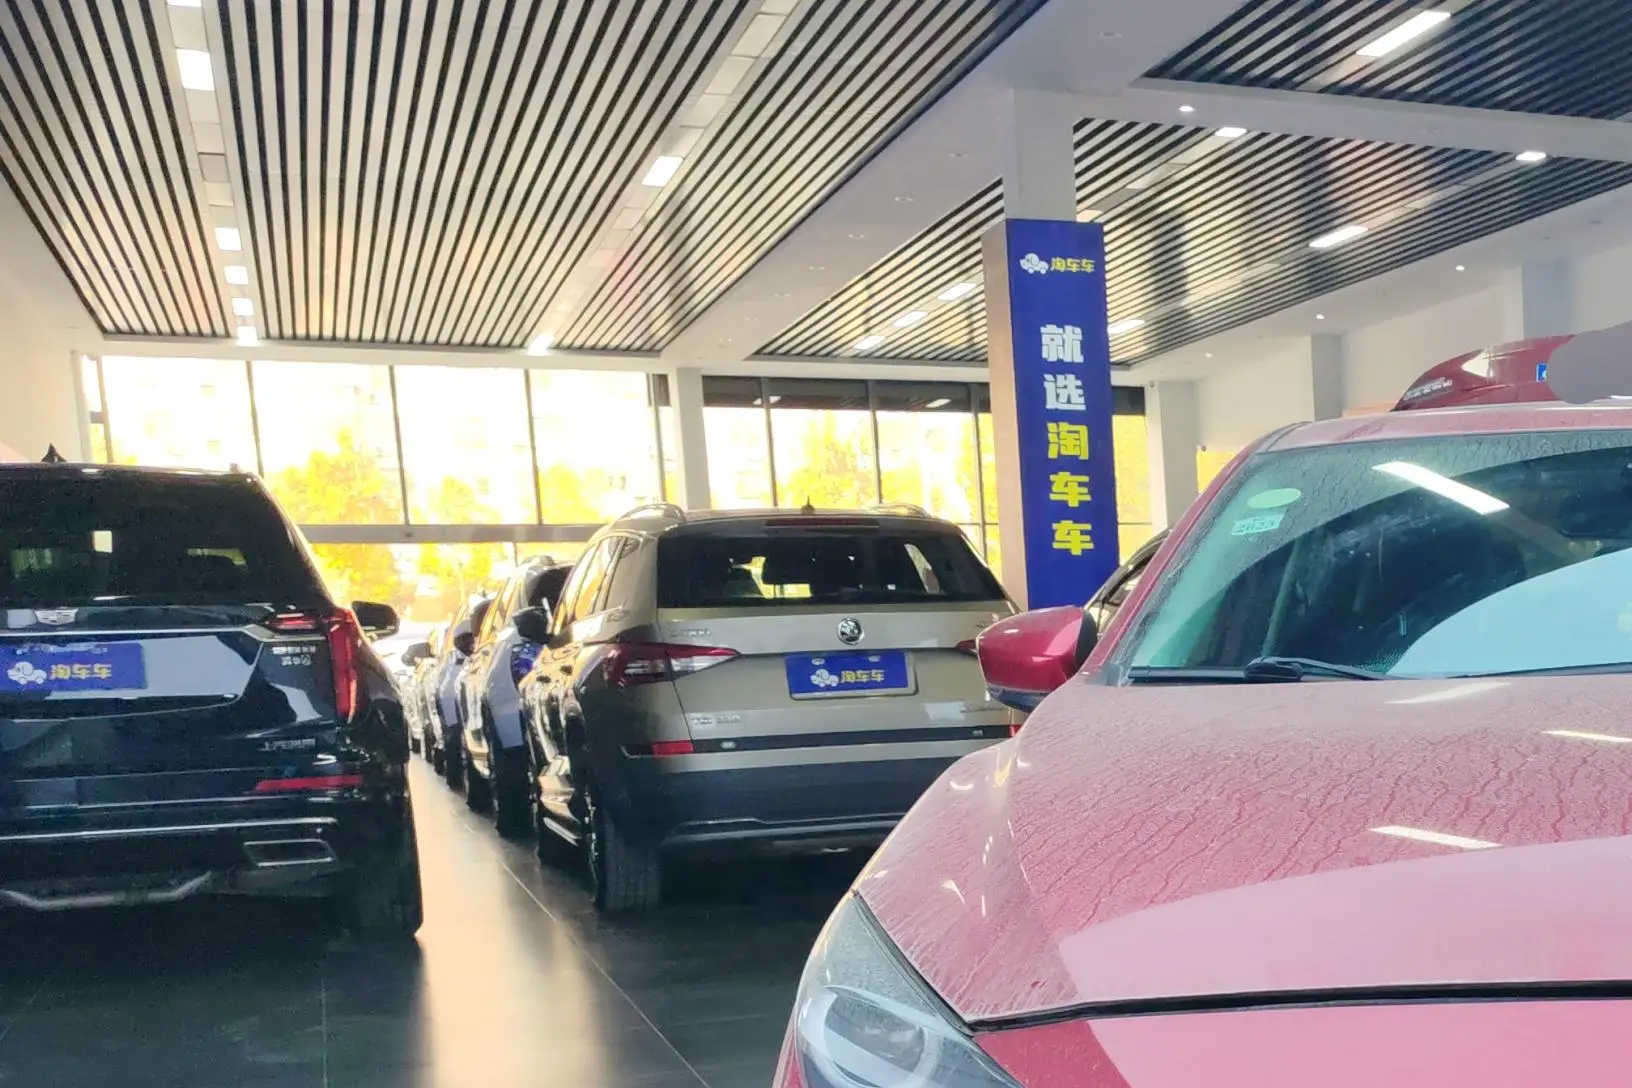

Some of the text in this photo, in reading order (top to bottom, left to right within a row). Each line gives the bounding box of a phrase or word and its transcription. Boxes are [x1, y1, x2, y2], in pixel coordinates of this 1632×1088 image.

[1050, 256, 1095, 273] 淘车车
[1040, 323, 1095, 556] 就选淘车车
[50, 663, 112, 680] 淘车车
[841, 669, 885, 683] 淘车车
